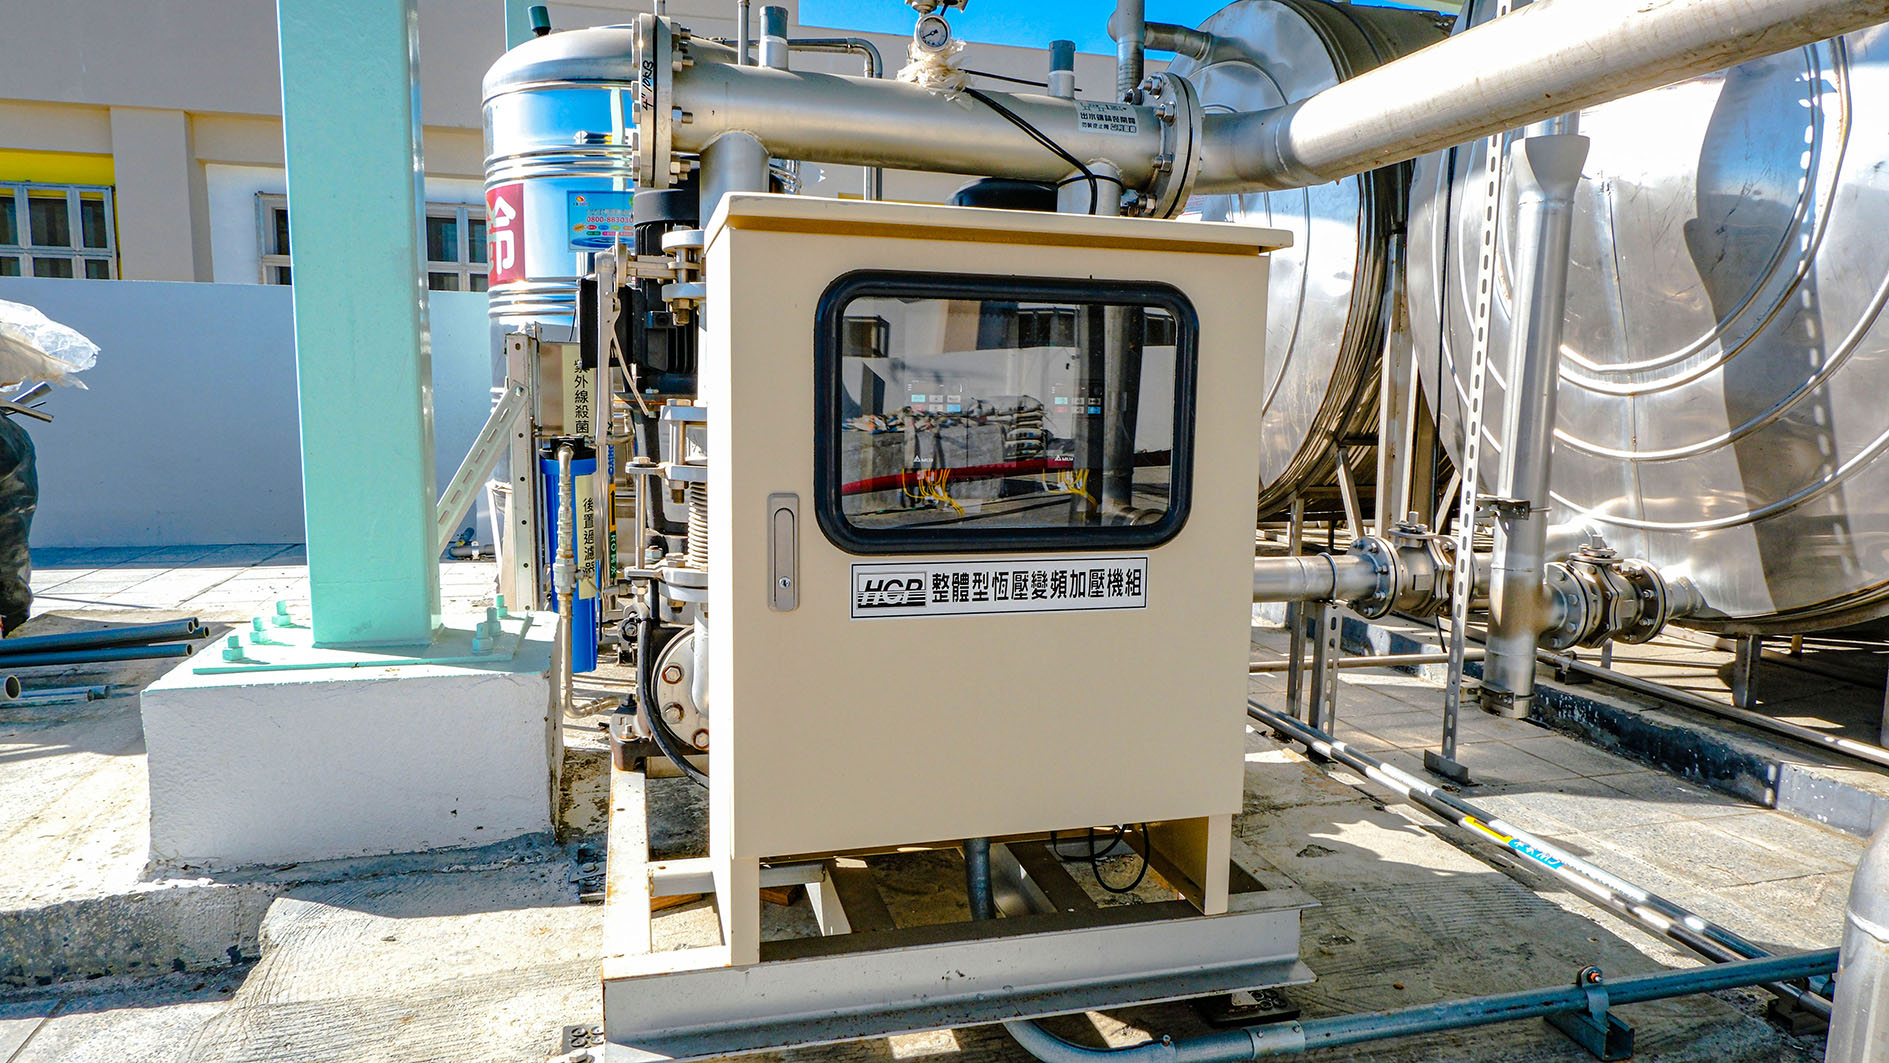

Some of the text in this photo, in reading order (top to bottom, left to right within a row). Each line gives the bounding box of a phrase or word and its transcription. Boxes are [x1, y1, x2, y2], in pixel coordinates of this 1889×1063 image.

[932, 568, 1142, 603] 整體型恆壓變頻加壓機組
